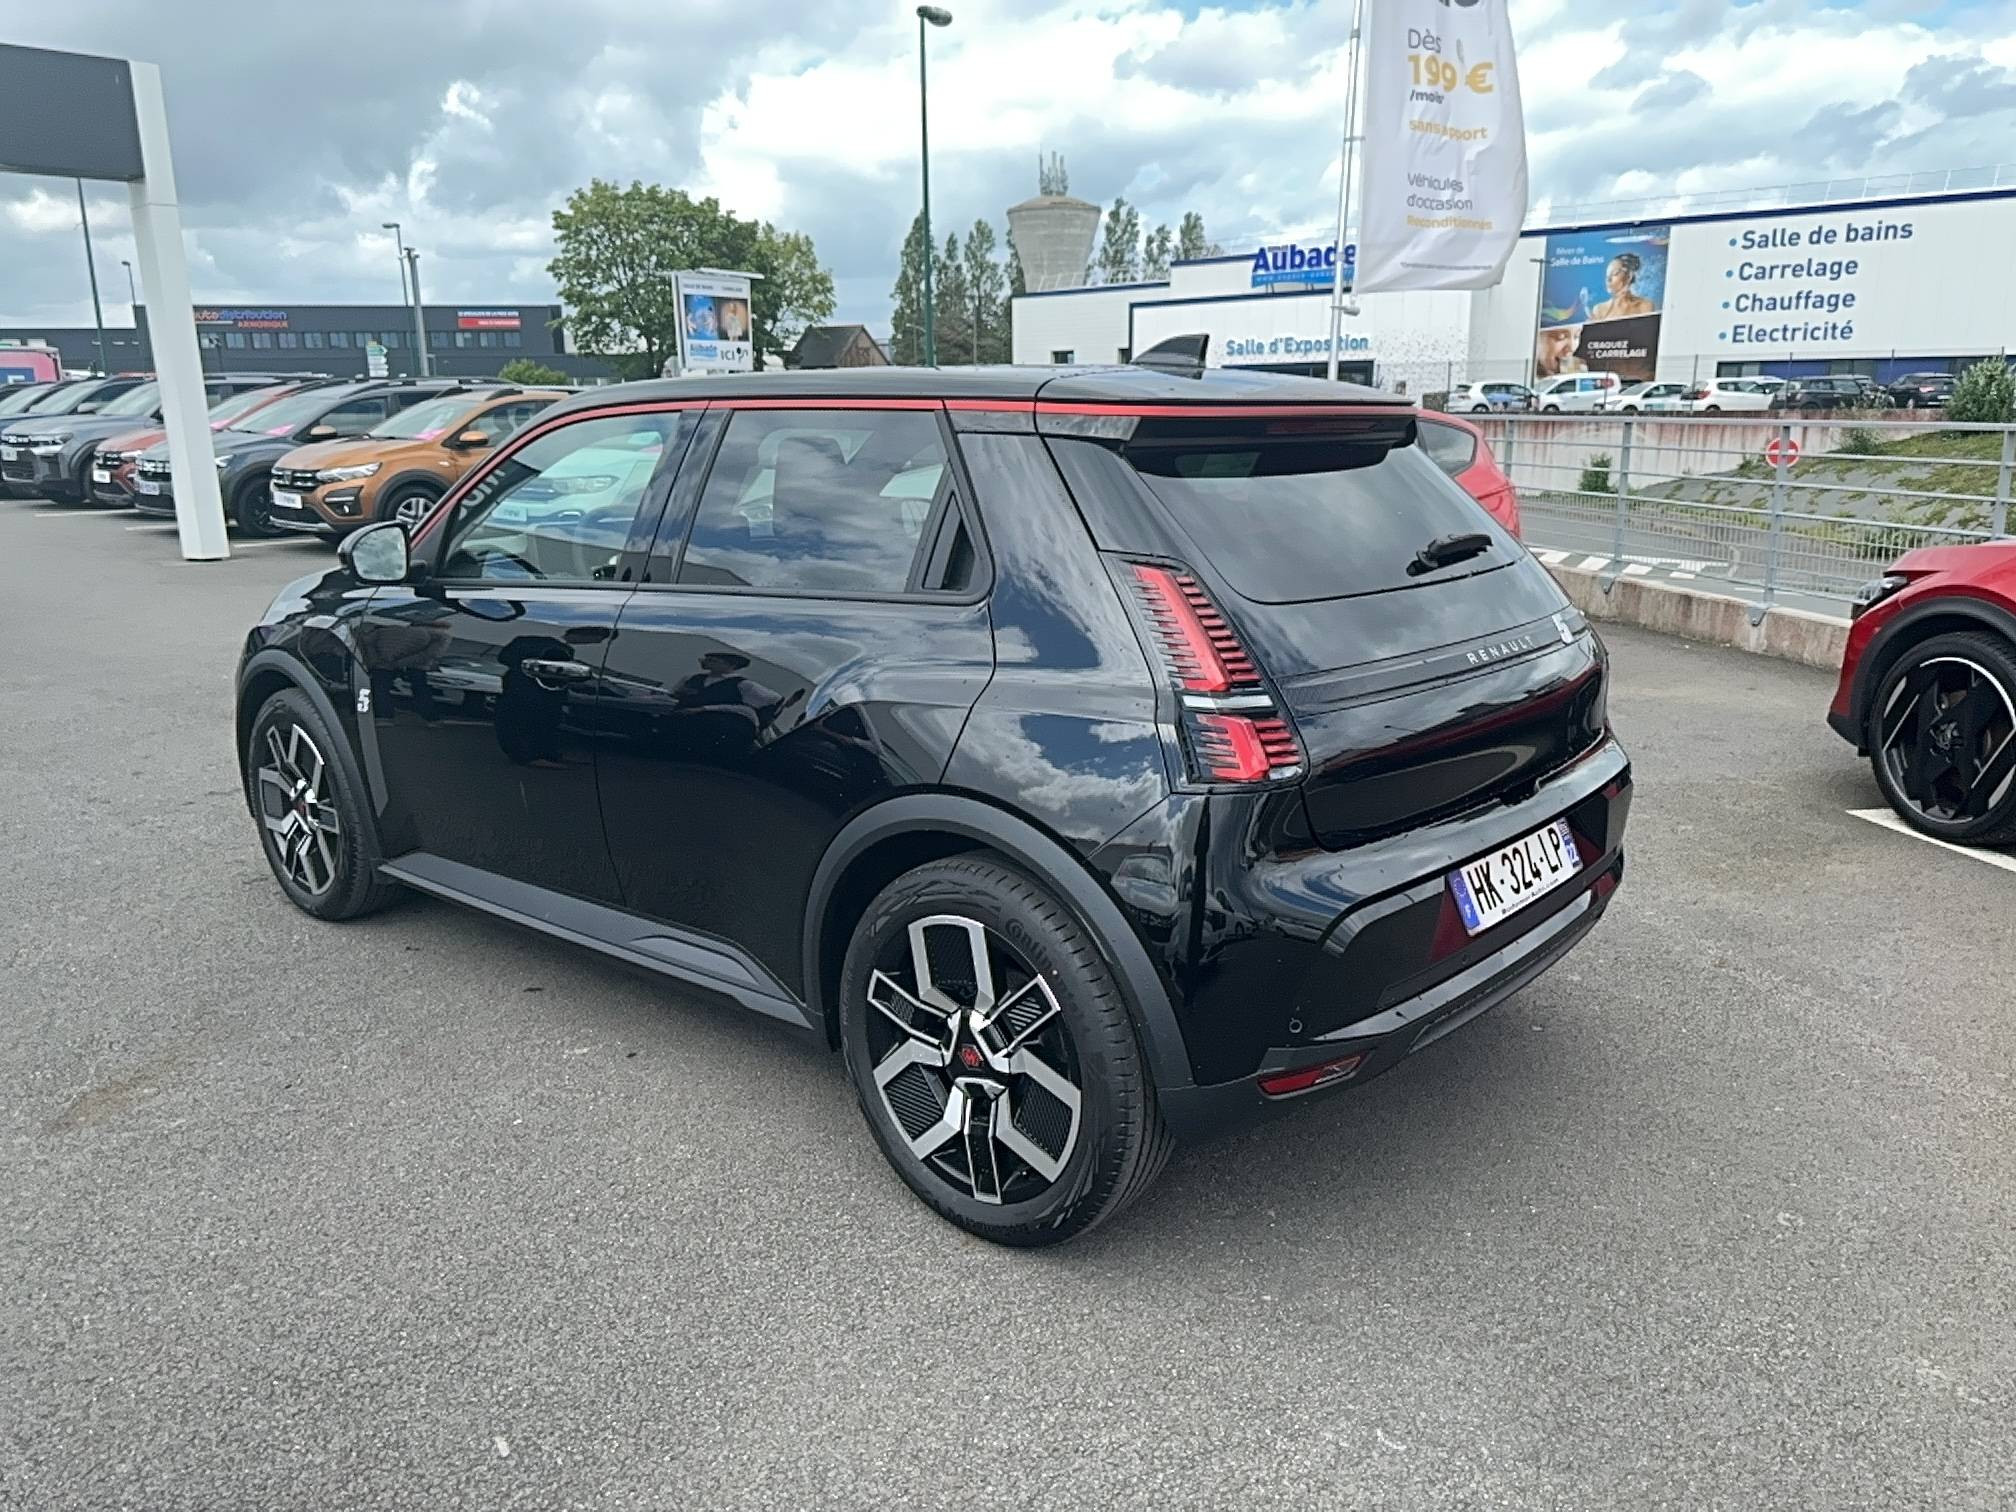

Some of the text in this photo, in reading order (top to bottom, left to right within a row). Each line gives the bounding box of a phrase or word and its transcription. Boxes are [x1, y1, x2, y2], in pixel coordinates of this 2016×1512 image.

[1408, 29, 1442, 53] Dès
[1408, 55, 1494, 94] 199 €
[1407, 172, 1464, 193] Véhicules
[1407, 193, 1473, 211] d'occasion
[1741, 220, 1913, 250] Salle de bains
[1252, 240, 1357, 273] Aubade
[1739, 258, 1859, 281] Carrelage
[1735, 290, 1856, 313] Chauffage
[1732, 320, 1853, 343] Electricité
[1226, 335, 1369, 357] Salle d'Expostion
[1587, 340, 1629, 350] CRAQUEZ
[1595, 348, 1648, 359] CARRELAGE
[1466, 635, 1534, 665] RENAULT
